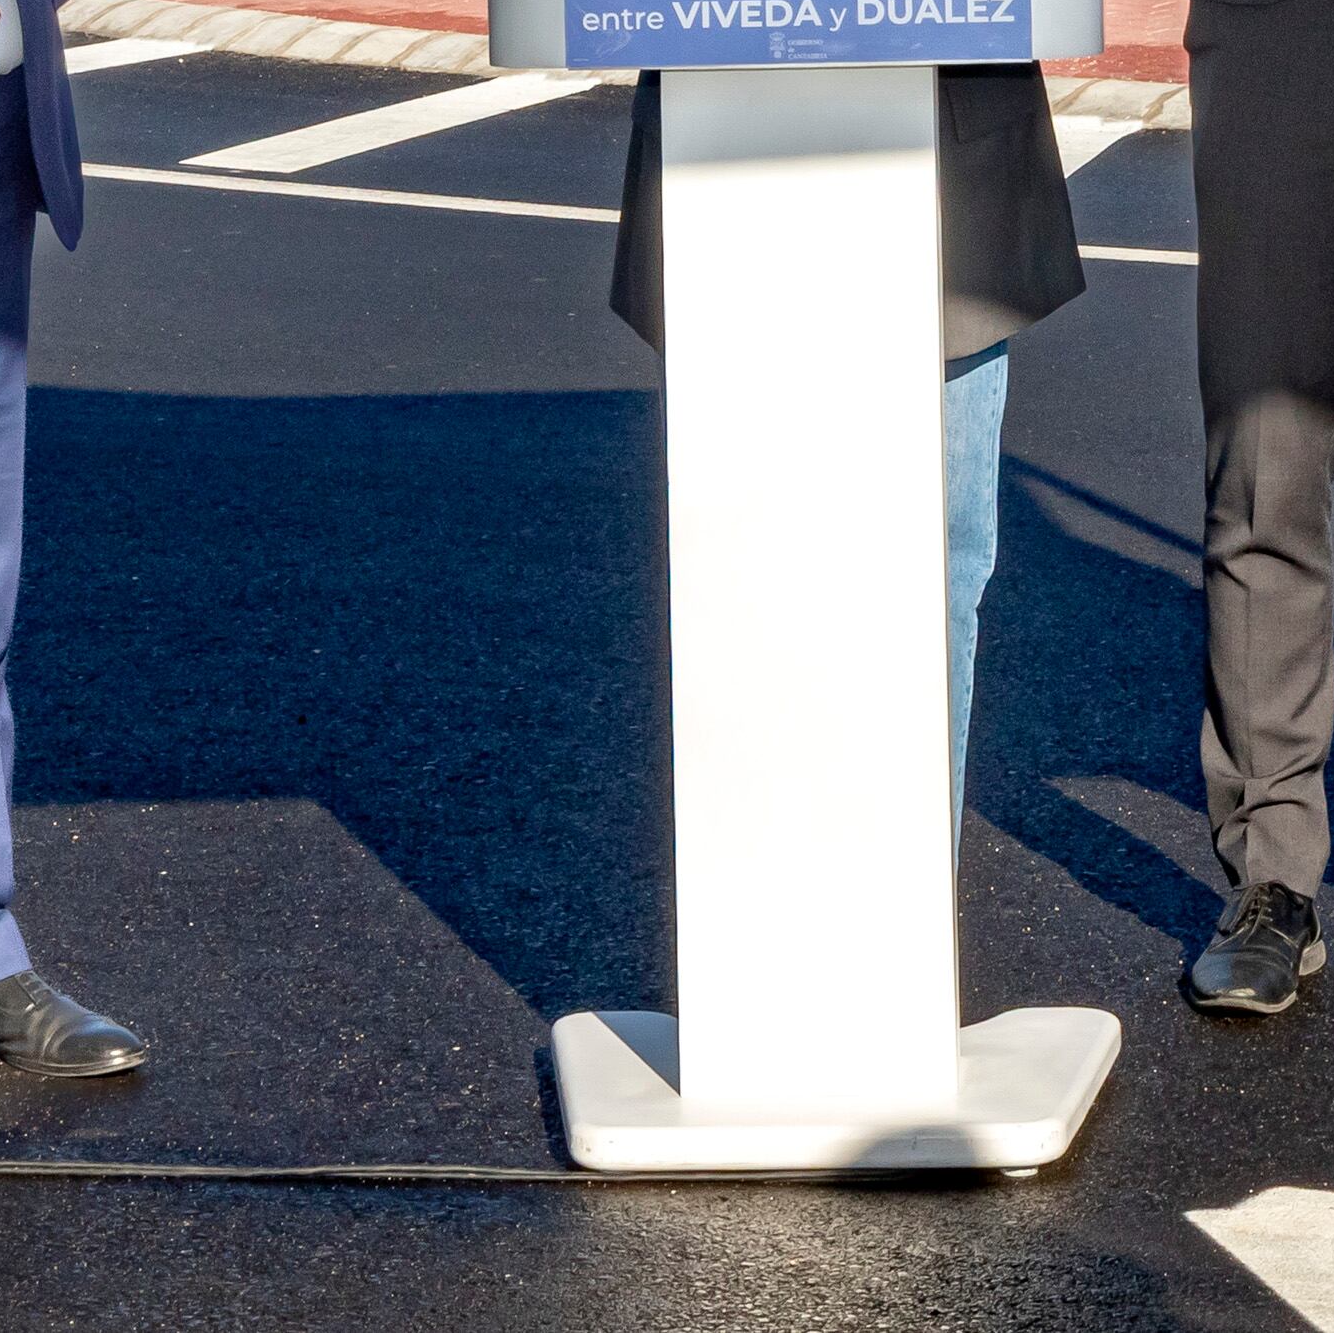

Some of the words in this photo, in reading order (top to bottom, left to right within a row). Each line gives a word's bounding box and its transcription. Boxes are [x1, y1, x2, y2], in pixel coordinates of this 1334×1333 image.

[582, 9, 664, 32] entre
[672, 0, 823, 29] VIVEDA
[829, 7, 847, 32] y
